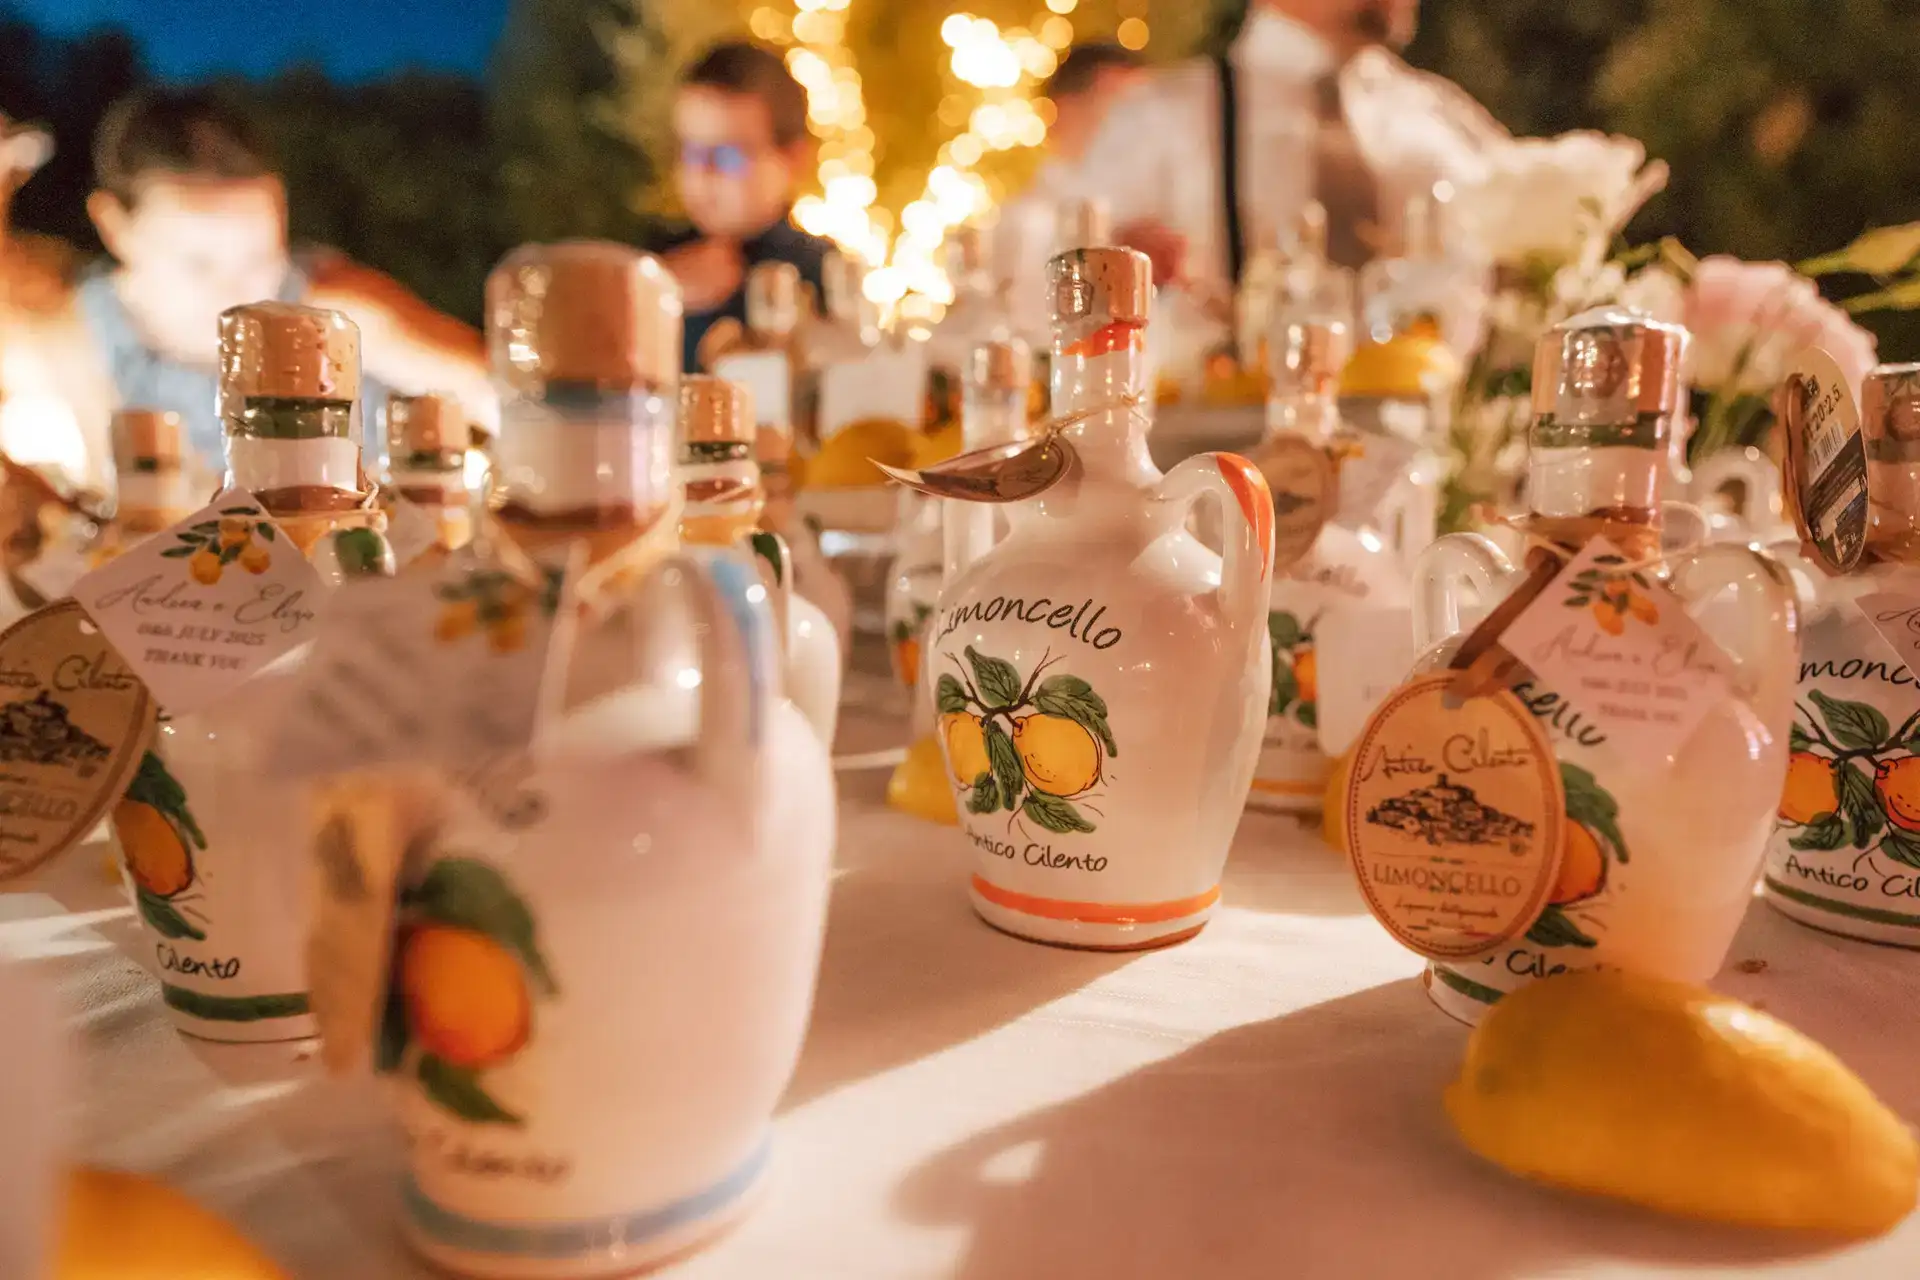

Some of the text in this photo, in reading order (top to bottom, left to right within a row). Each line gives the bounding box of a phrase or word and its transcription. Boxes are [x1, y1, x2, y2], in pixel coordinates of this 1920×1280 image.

[965, 824, 1109, 873] Antico Cilento
[1372, 862, 1523, 897] LIMONCELLO
[1785, 854, 1869, 892] Antico
